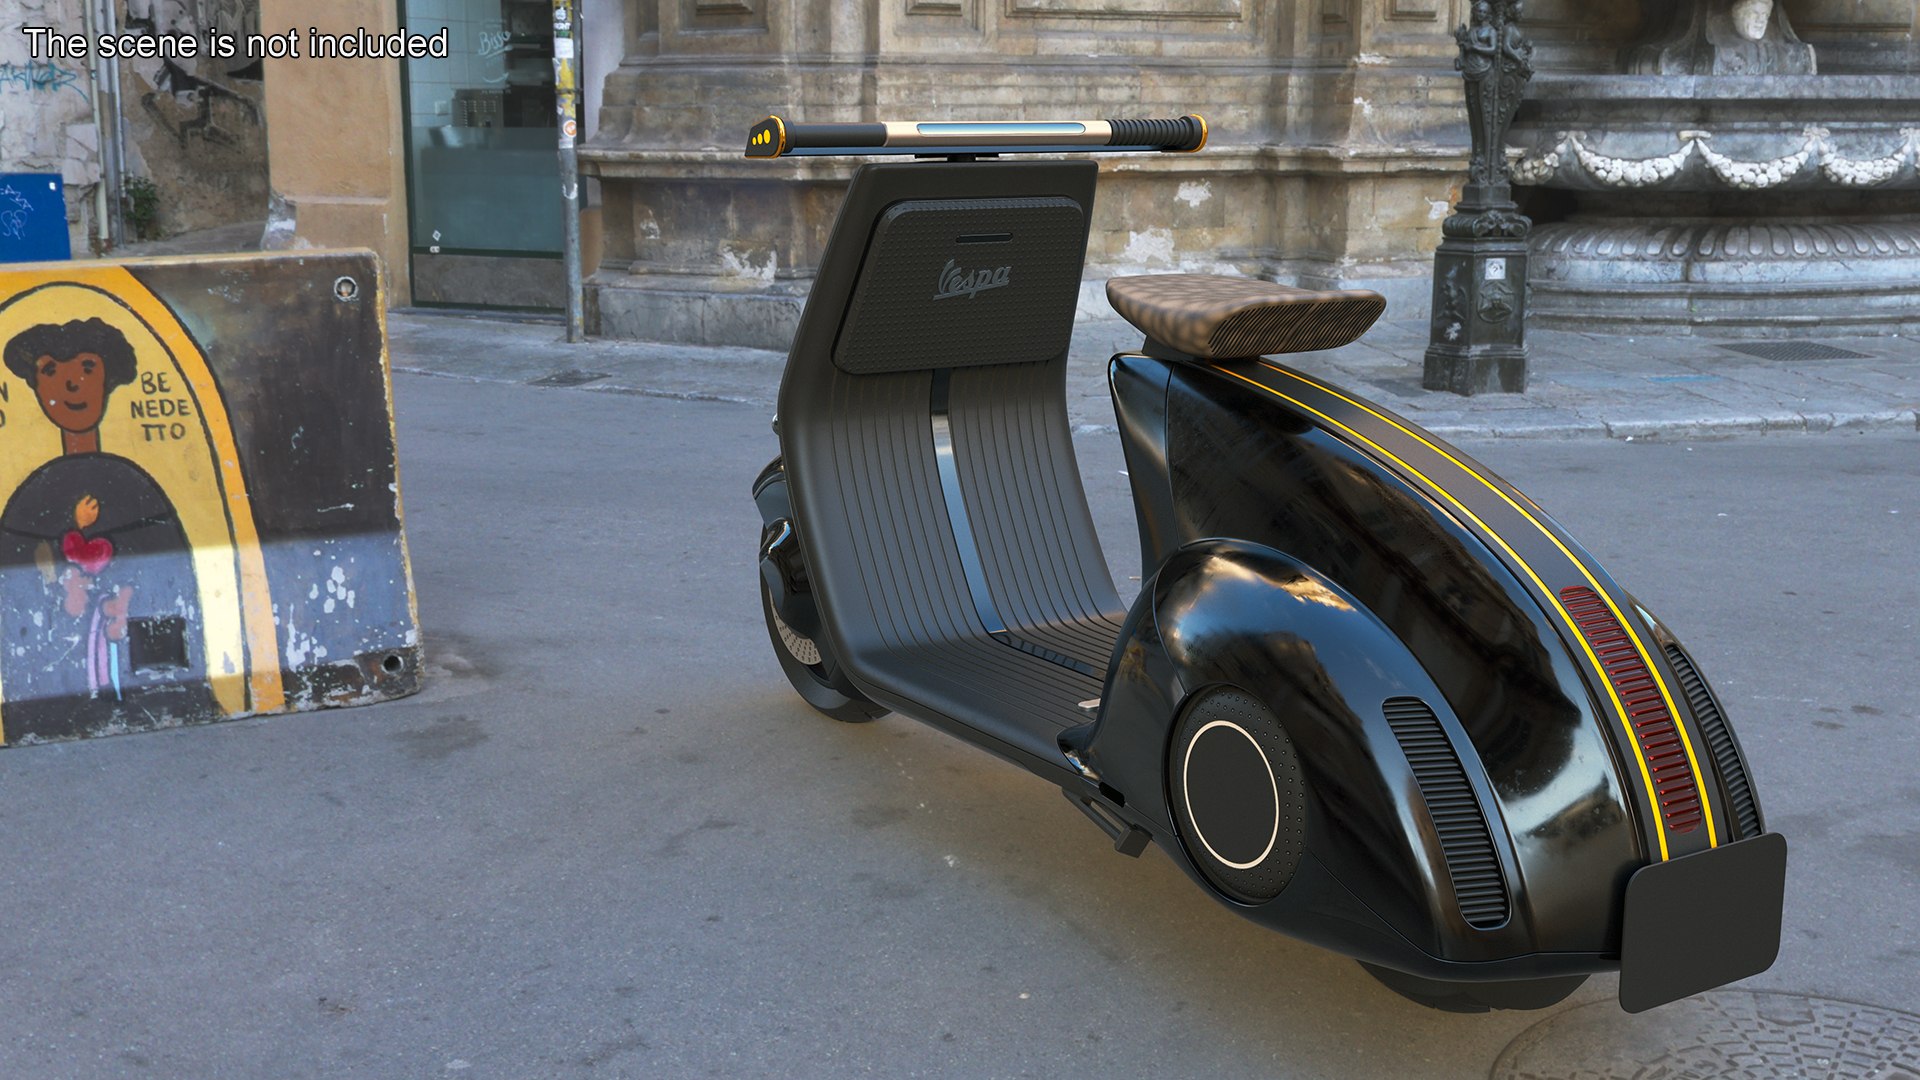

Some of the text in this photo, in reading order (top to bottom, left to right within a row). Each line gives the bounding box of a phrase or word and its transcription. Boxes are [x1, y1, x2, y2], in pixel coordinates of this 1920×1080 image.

[932, 258, 1012, 300] Vespa
[141, 371, 171, 395] BE
[130, 398, 192, 419] NEDE
[141, 422, 186, 442] TTO
